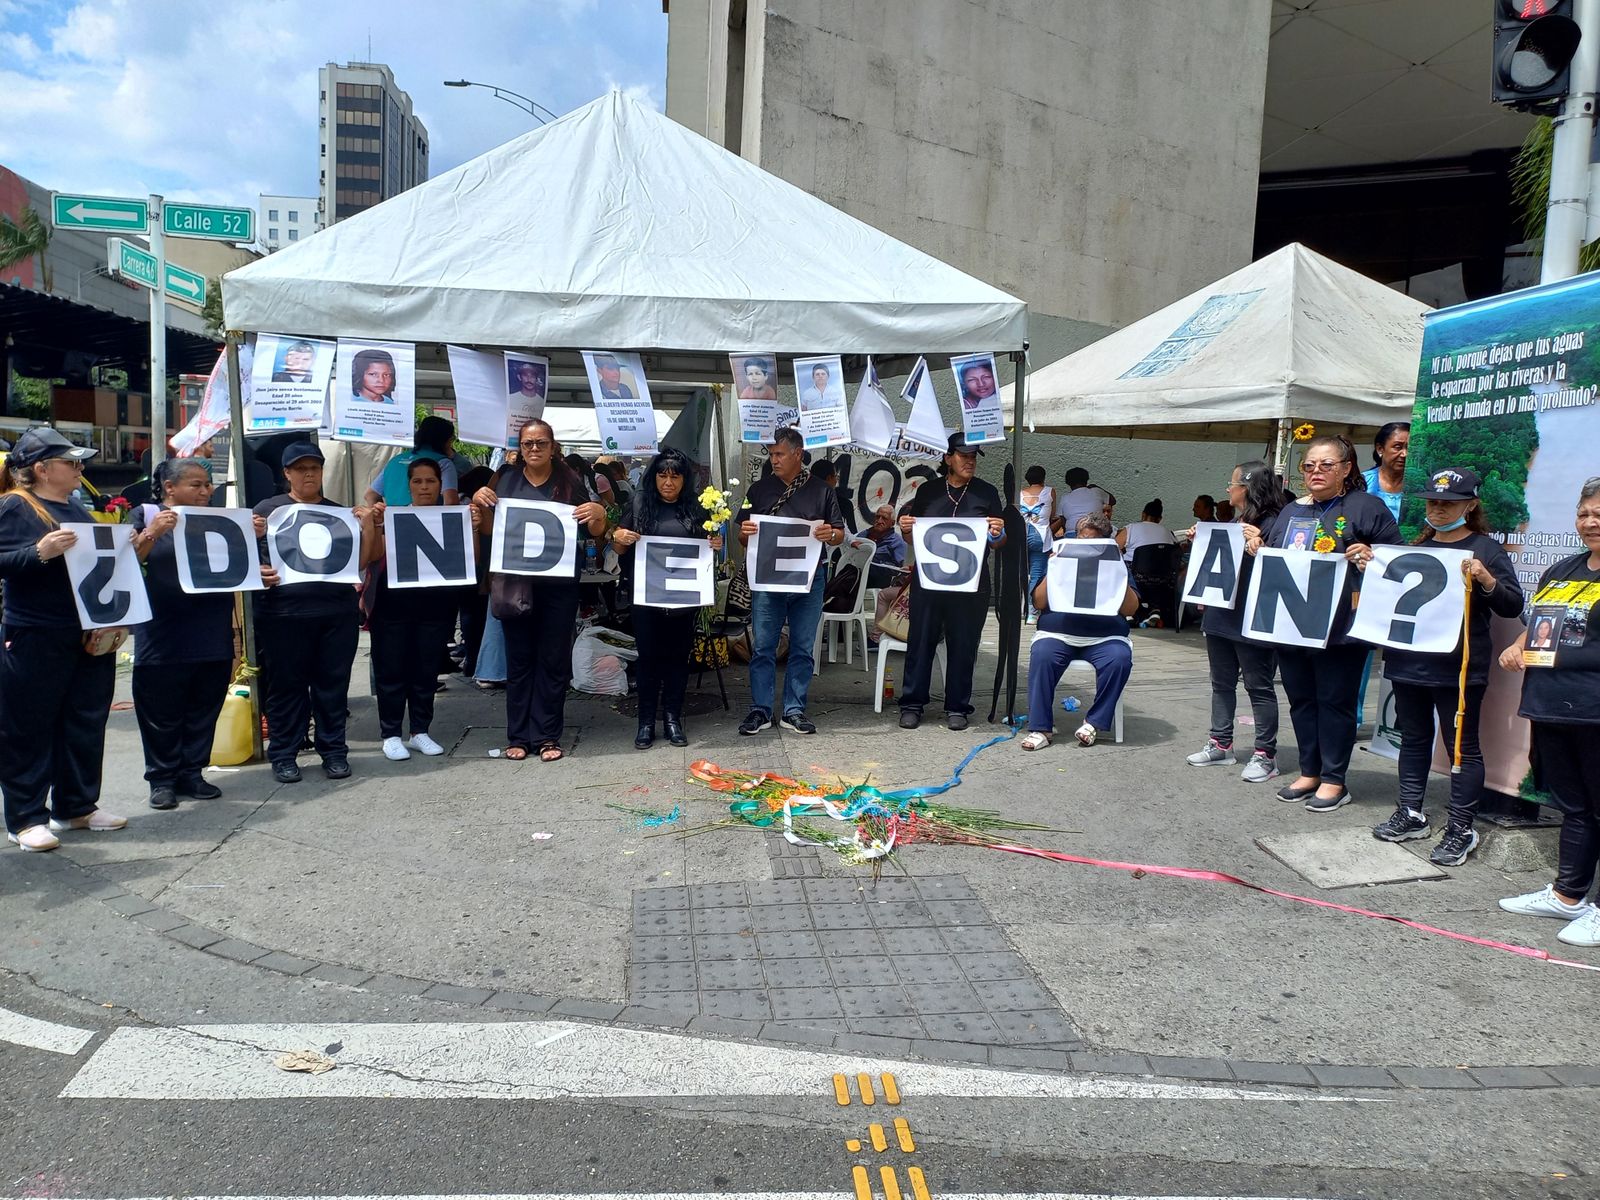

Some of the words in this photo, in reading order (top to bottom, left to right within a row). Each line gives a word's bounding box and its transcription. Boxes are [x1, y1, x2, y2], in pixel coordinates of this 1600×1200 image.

[174, 210, 212, 231] Calle
[223, 214, 241, 234] 52
[122, 248, 146, 279] Carrera
[145, 263, 155, 281] 46
[1431, 381, 1440, 398] Se
[1440, 377, 1476, 398] esparzan
[1477, 374, 1495, 394] por
[1495, 370, 1510, 389] las
[1511, 364, 1545, 387] riveras
[1545, 364, 1554, 384] y
[1555, 361, 1566, 380] la
[1489, 344, 1514, 365] dejas
[1515, 341, 1533, 362] que
[1535, 337, 1551, 356] tus
[1552, 332, 1584, 355] aguas
[1427, 403, 1452, 423] Verdad
[1453, 404, 1463, 419] se
[1464, 398, 1492, 418] hunda
[1493, 398, 1505, 415] en
[1506, 395, 1517, 413] lo
[1540, 384, 1598, 413] profundo?
[185, 514, 249, 589] D
[275, 510, 354, 575] O
[393, 513, 467, 582] N
[502, 507, 565, 572] D
[755, 521, 811, 586] E
[921, 523, 978, 585] S
[1188, 529, 1236, 601] A
[1507, 531, 1526, 545] mis
[1528, 531, 1560, 546] aguas
[1521, 552, 1534, 564] en
[1537, 551, 1547, 565] la
[78, 526, 130, 624] ¿
[645, 542, 701, 604] E
[1057, 543, 1121, 608] T
[1250, 555, 1337, 640] N
[1382, 553, 1448, 645] ?
